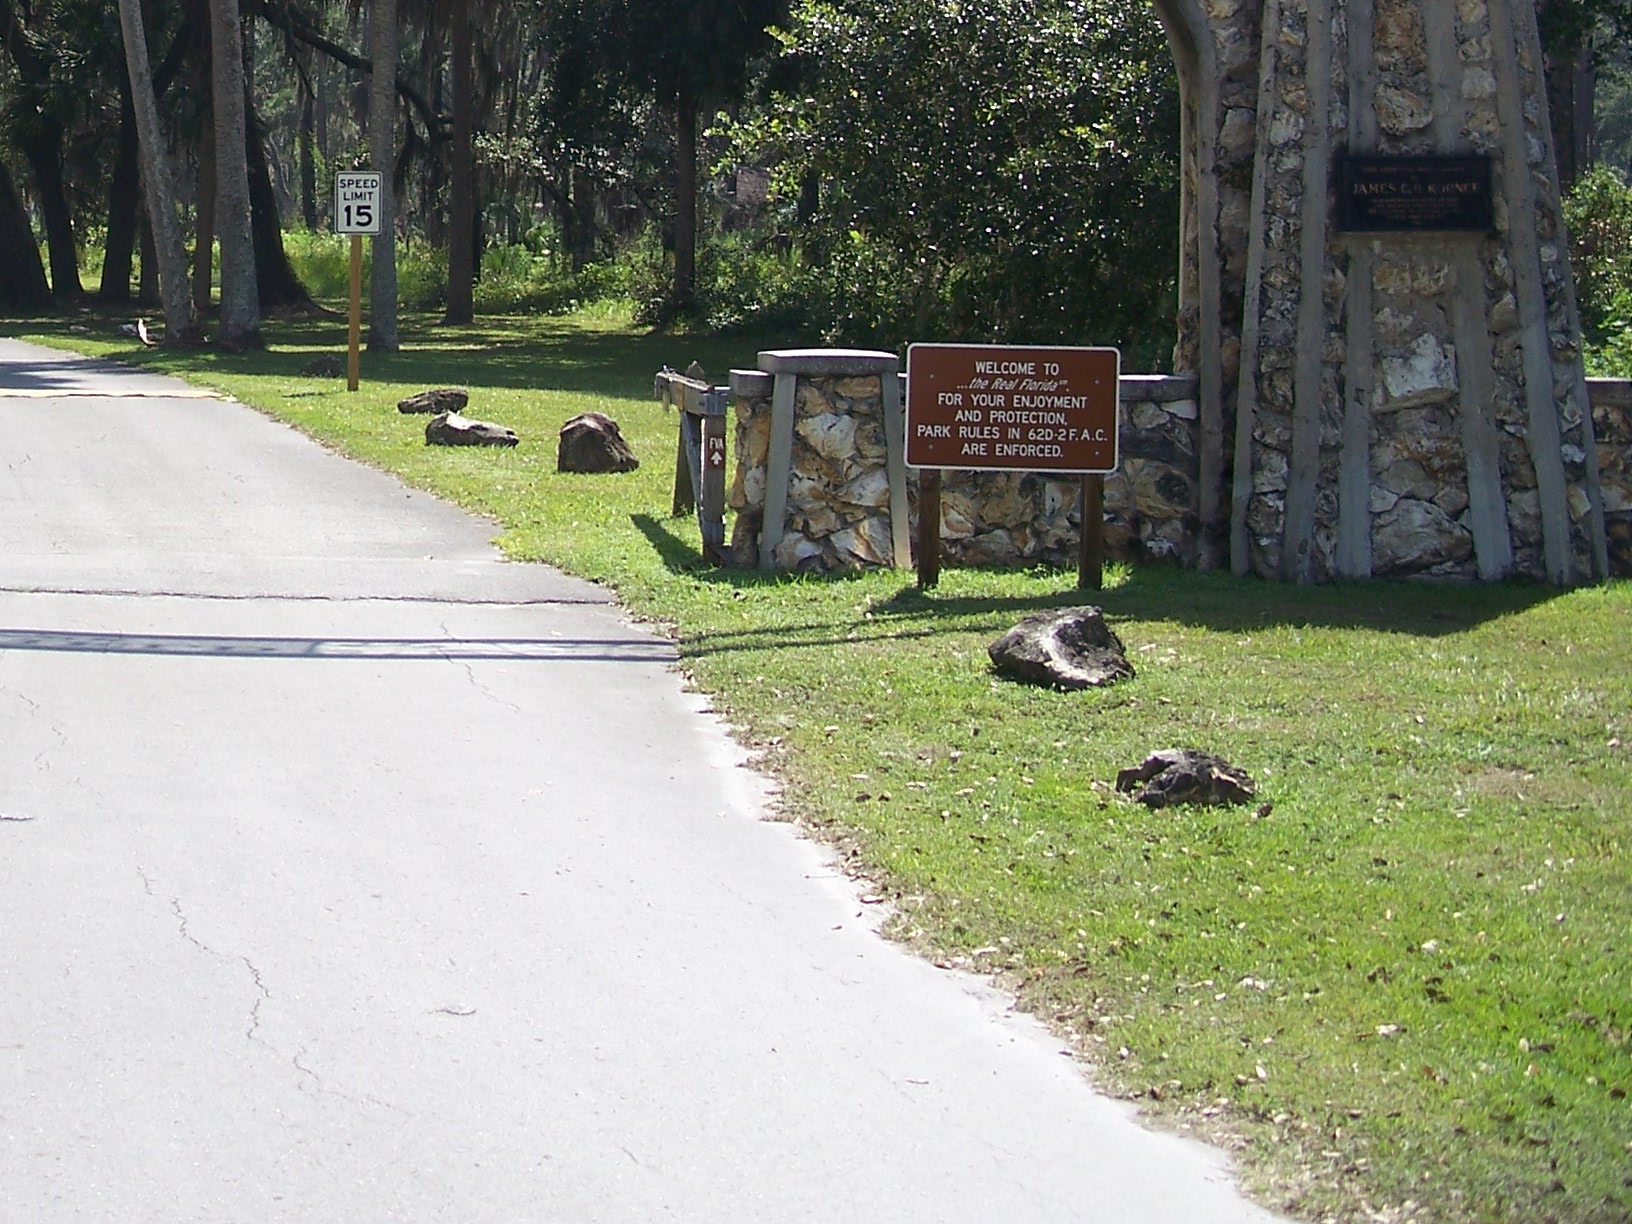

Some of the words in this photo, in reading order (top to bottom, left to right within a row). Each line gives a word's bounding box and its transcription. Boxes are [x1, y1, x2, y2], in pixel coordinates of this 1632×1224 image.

[339, 179, 379, 189] SPEED
[343, 191, 374, 201] LIMIT
[344, 205, 373, 227] 15
[975, 361, 1036, 375] WELCOME
[1043, 362, 1059, 376] TO
[990, 377, 1019, 391] Real
[937, 392, 963, 406] FOR
[970, 393, 1005, 407] YOUR
[1013, 395, 1088, 409] ENJOYMENT
[955, 409, 982, 422] AND
[917, 424, 952, 438] PARK
[958, 425, 1000, 439] RULES
[1008, 426, 1021, 440] IN
[961, 442, 988, 456] ARE
[995, 443, 1064, 458] ENFORCED.
